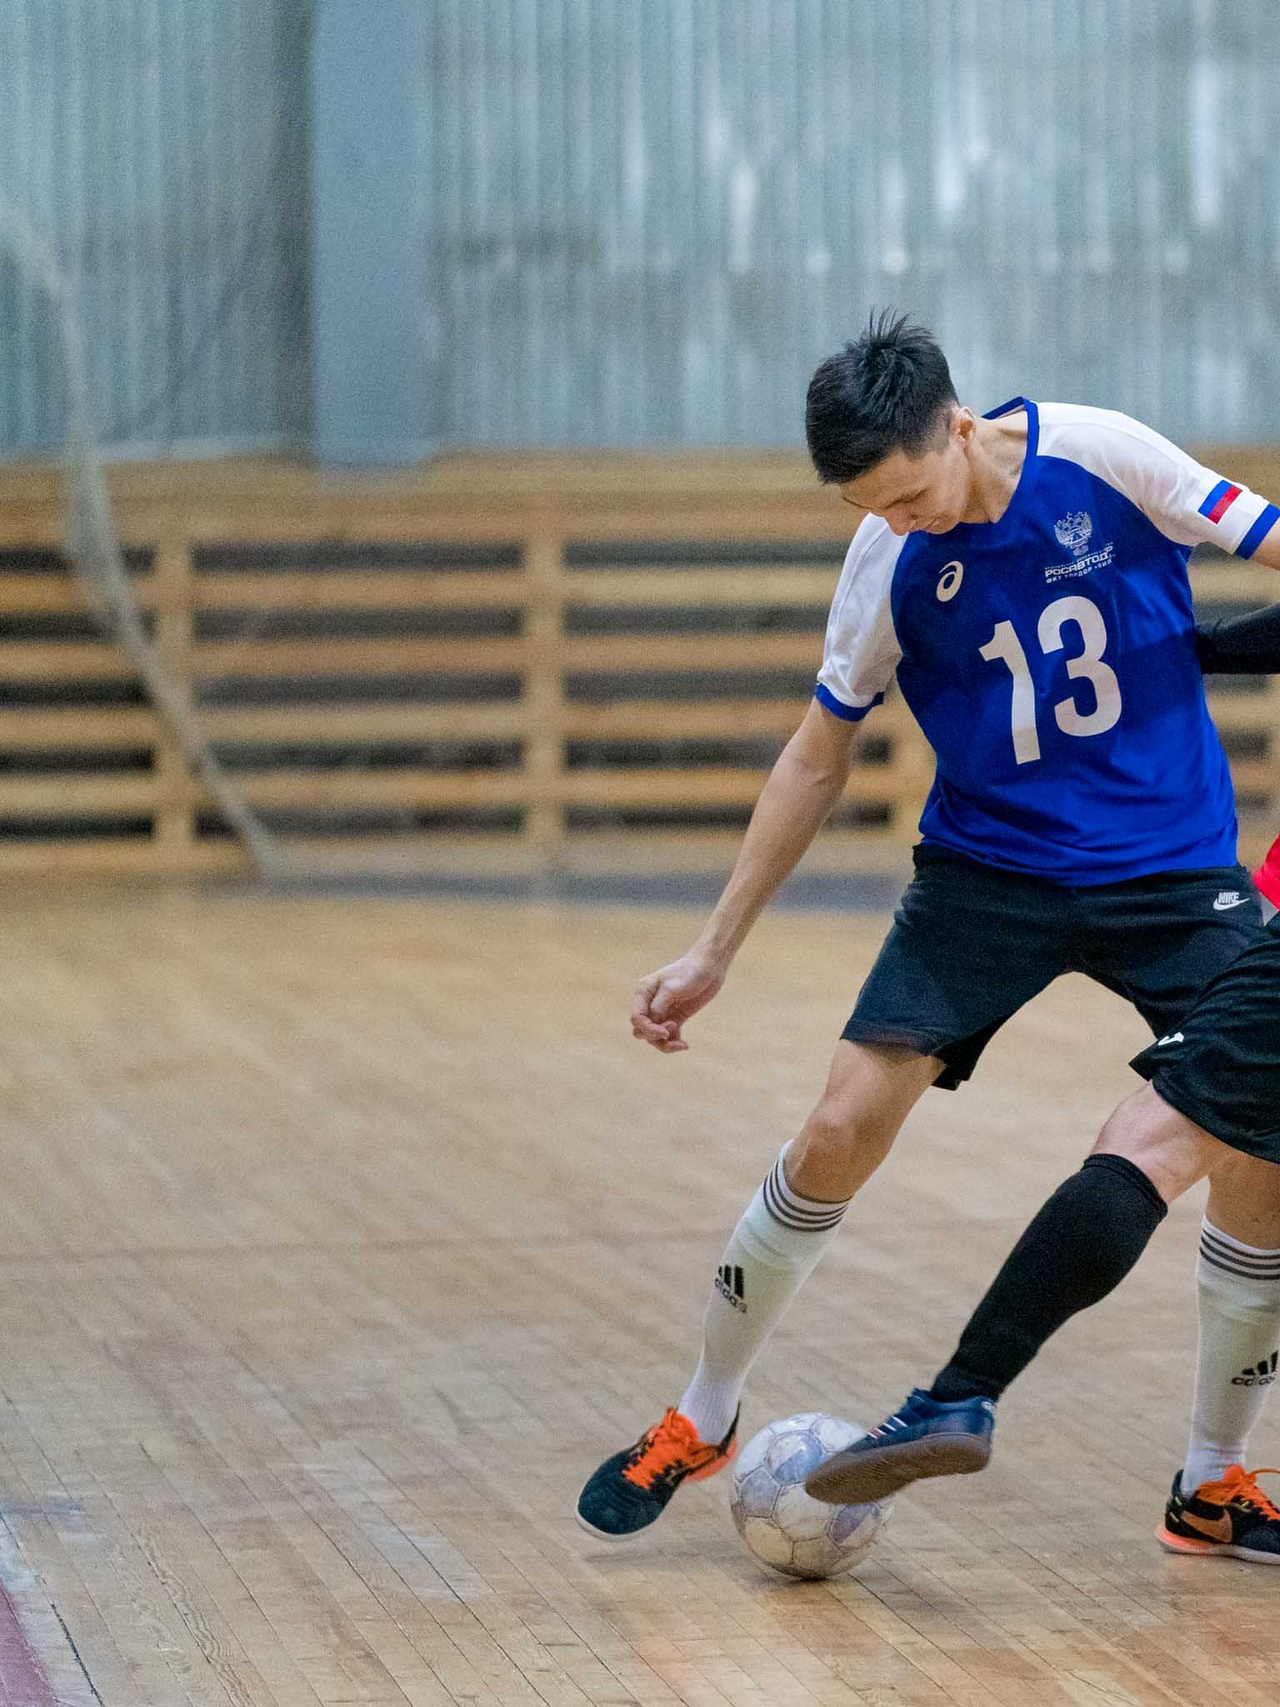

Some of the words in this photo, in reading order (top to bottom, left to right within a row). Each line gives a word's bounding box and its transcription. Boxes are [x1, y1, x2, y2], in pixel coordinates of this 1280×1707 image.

[1045, 545, 1114, 578] РОСАВТОДР
[979, 595, 1122, 764] 13
[1218, 891, 1240, 904] NIKE
